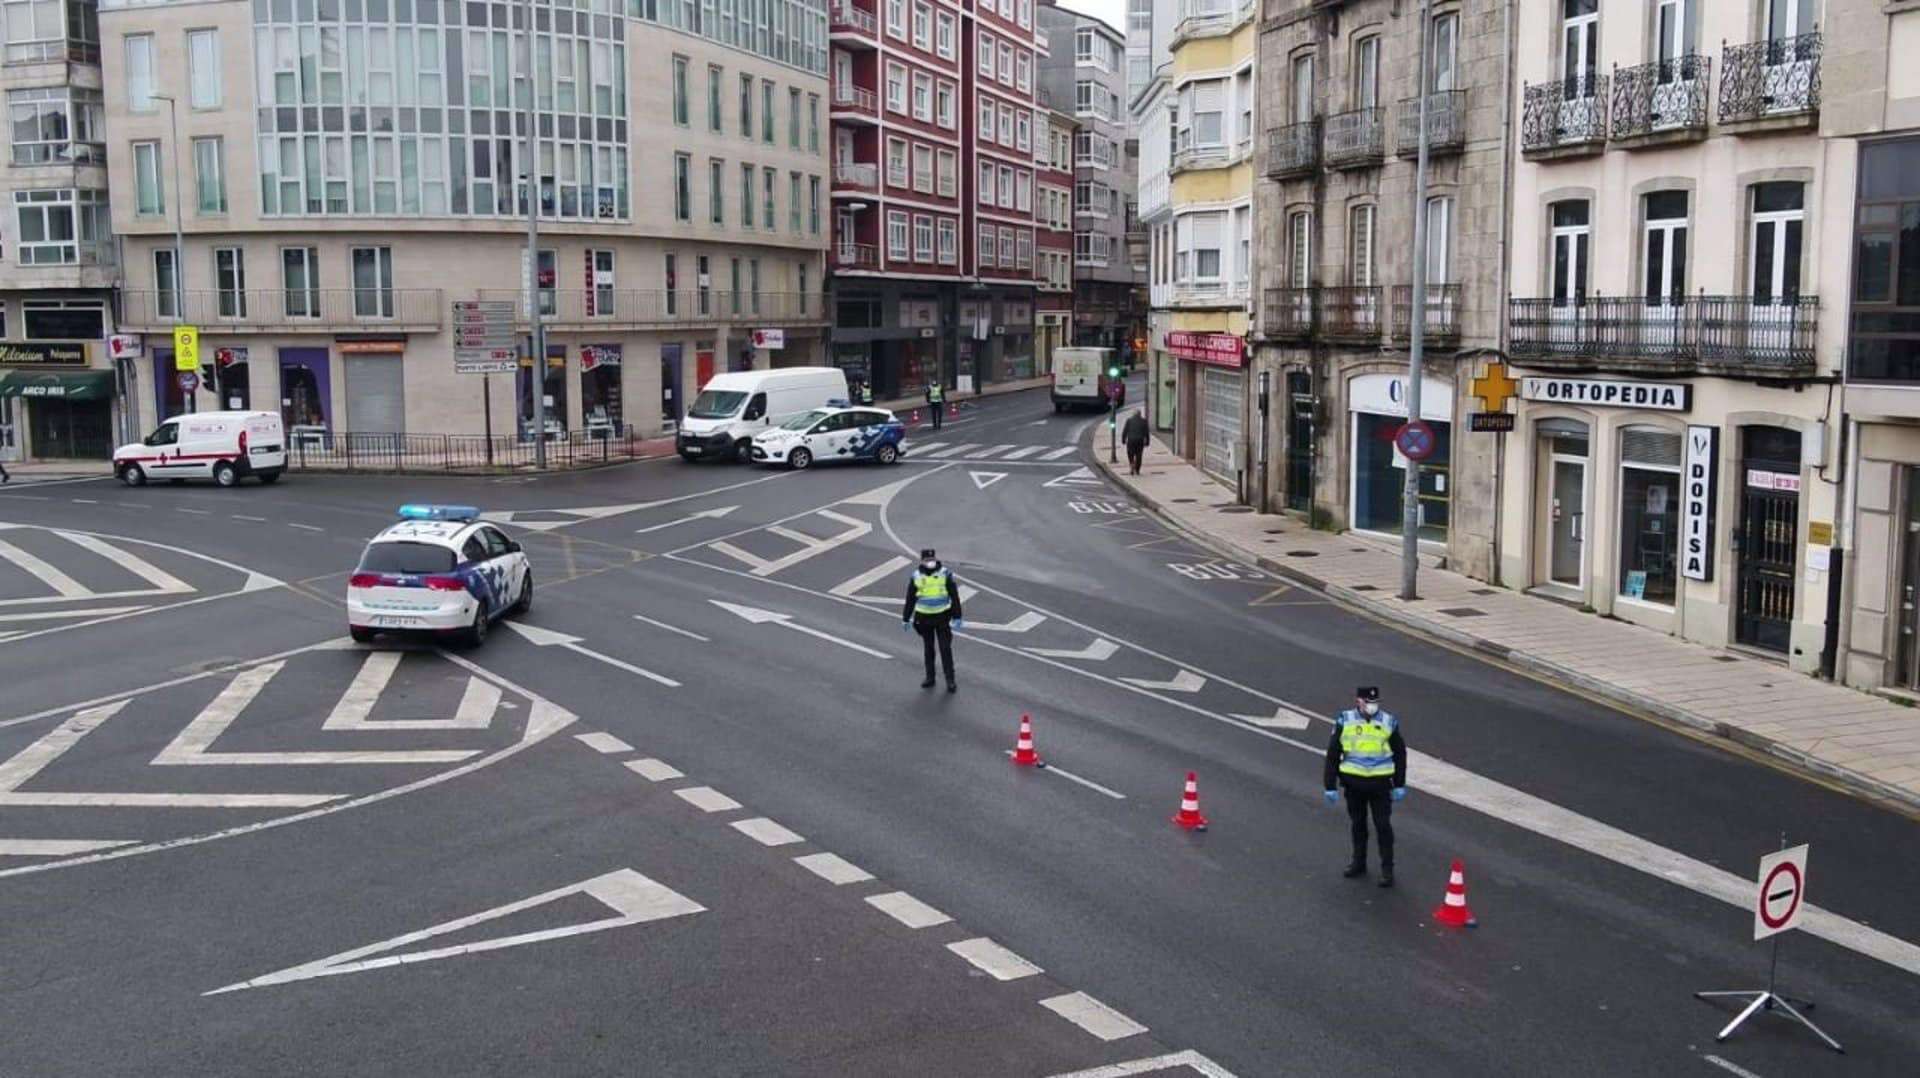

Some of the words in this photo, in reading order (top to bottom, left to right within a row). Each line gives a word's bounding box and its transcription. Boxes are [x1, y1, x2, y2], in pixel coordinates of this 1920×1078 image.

[22, 386, 46, 395] ARCO
[47, 386, 65, 395] IRIS
[1547, 382, 1676, 406] ORTOPEDIA
[1067, 500, 1139, 514] BUS
[1687, 463, 1704, 573] DODISA
[1166, 562, 1265, 580] BUS
